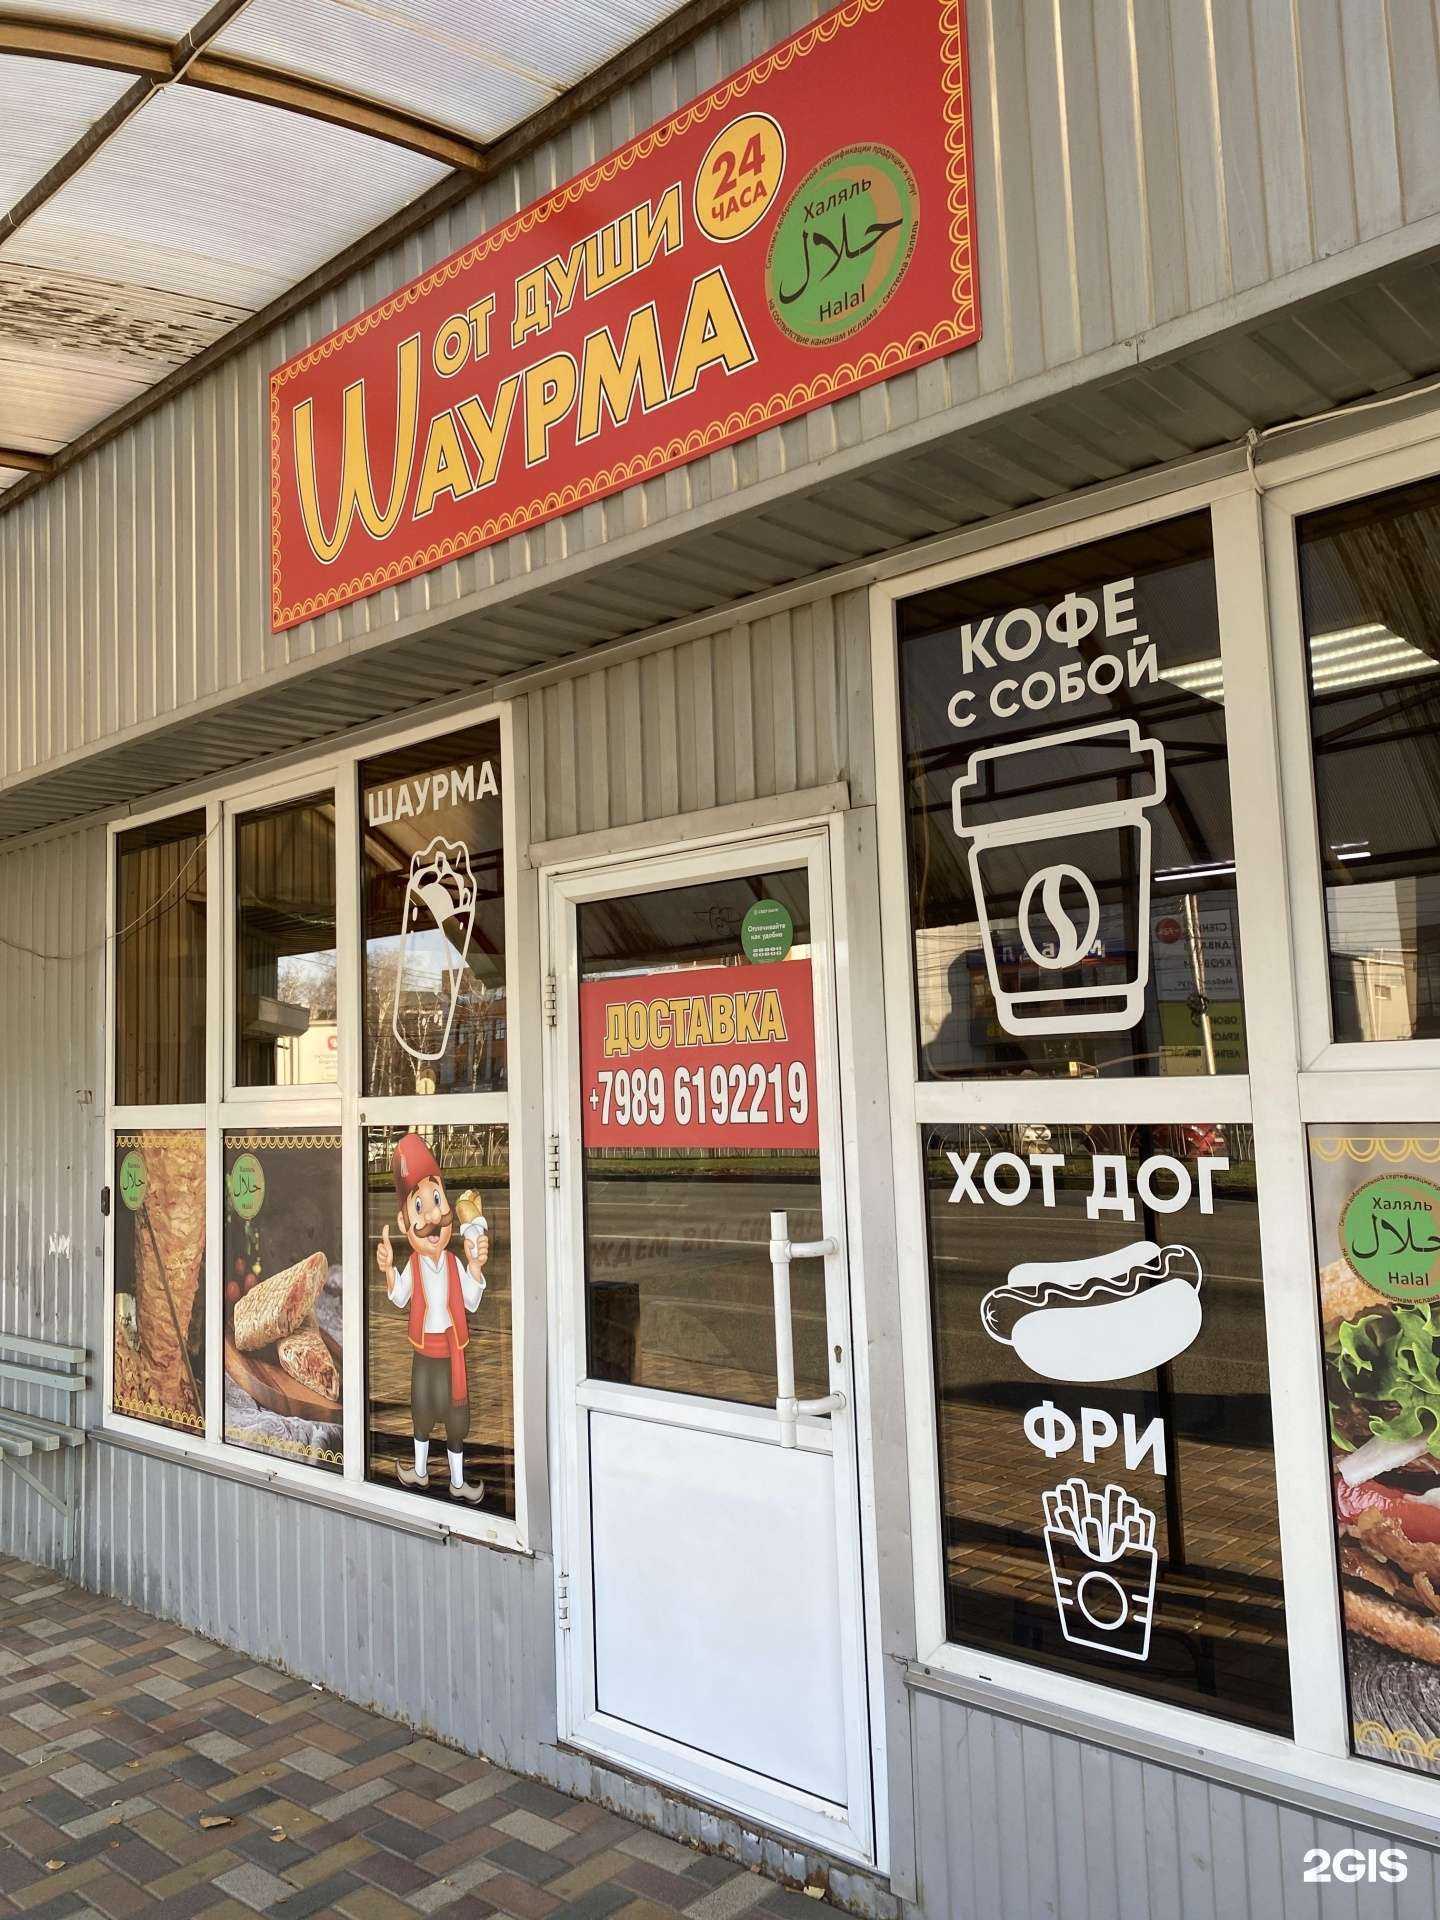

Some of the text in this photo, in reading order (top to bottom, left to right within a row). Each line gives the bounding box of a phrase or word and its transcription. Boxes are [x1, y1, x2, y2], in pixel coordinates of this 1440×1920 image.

[710, 133, 768, 198] 24
[710, 179, 768, 225] ЧАСА
[803, 177, 872, 223] Халяль
[433, 180, 683, 380] ОТ ДУШИ
[819, 283, 866, 322] Halal
[960, 577, 1138, 675] КОФЕ
[989, 635, 1159, 718] СОБОЙ
[368, 760, 499, 828] ШАУРМА
[604, 989, 788, 1057] ДОСТАВКА
[590, 1061, 809, 1126] +7989 6192219
[946, 1151, 1230, 1222] ХОТ ДОГ
[1372, 1197, 1433, 1212] Халяль
[1388, 1271, 1430, 1287] Halal
[1023, 1400, 1167, 1476] ФРИ
